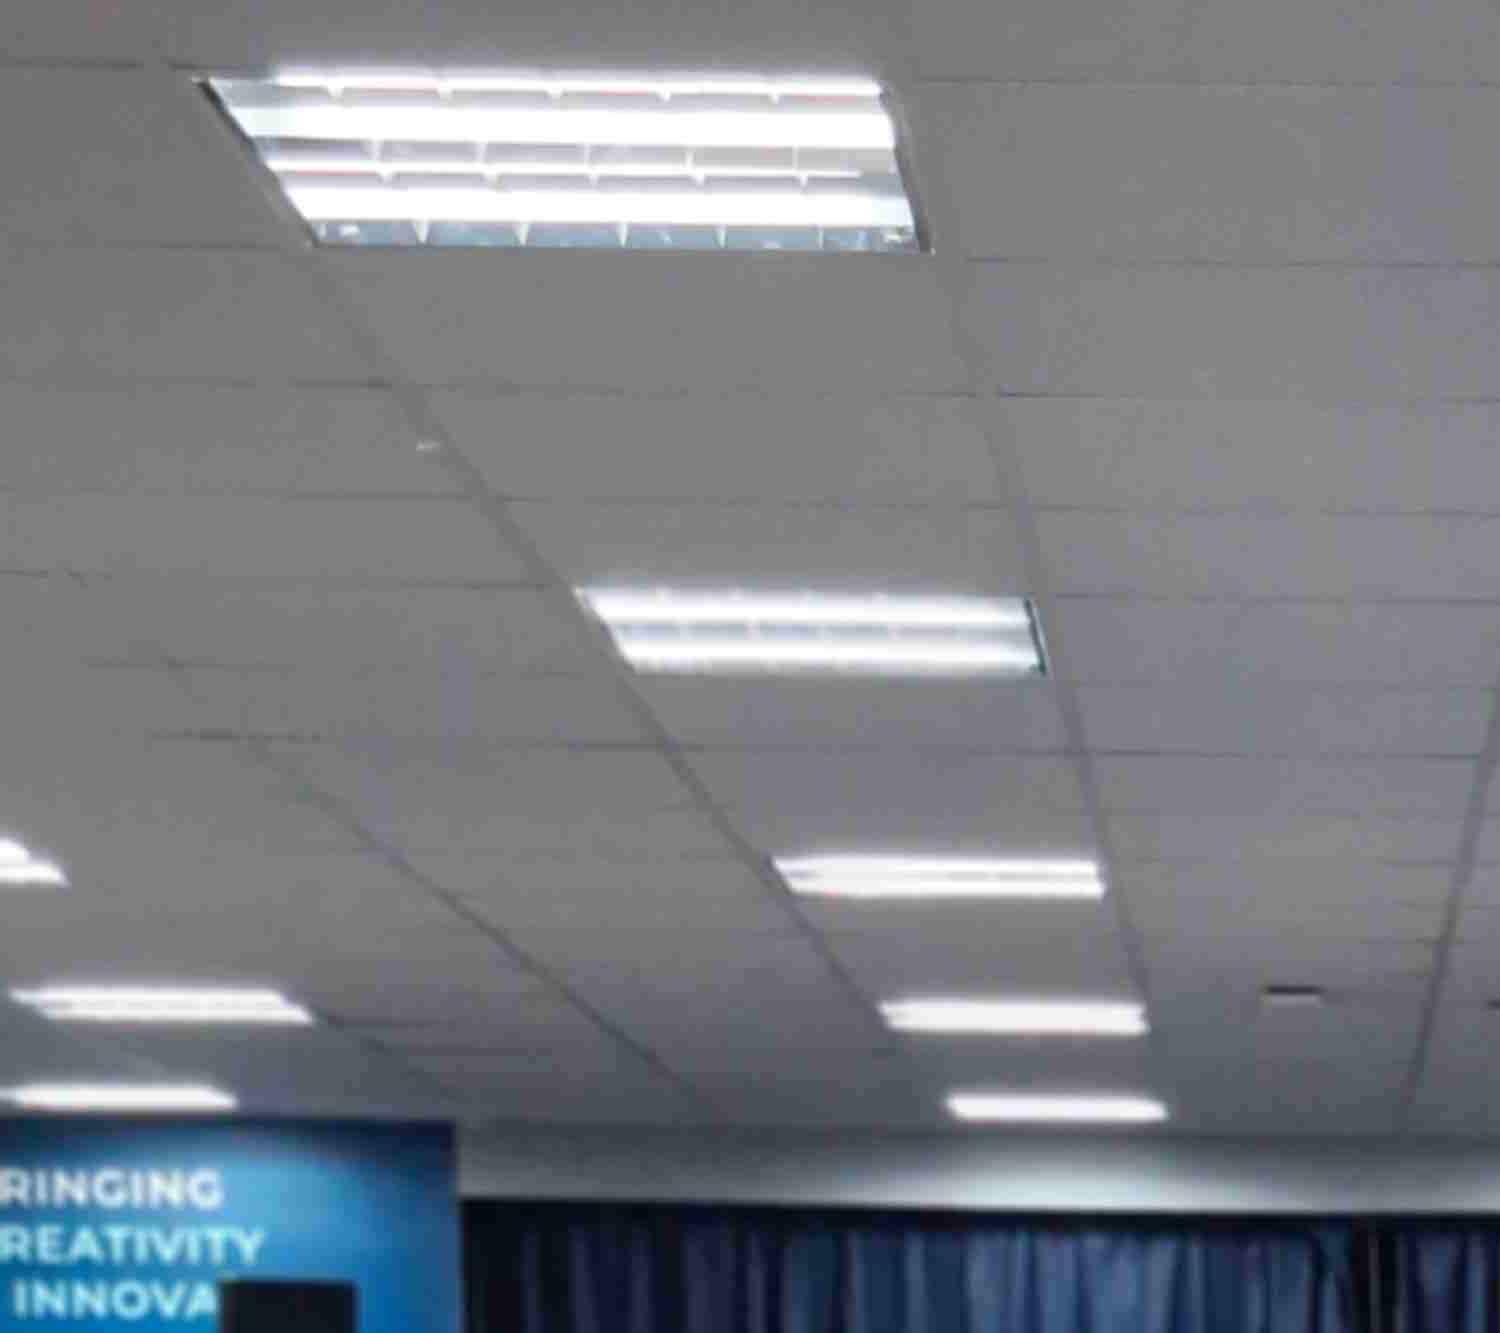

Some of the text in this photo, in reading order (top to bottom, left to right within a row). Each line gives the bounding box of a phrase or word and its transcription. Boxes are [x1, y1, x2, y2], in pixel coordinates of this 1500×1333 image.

[0, 1168, 223, 1208] RINGING
[0, 1225, 265, 1264] REATIVITY
[13, 1280, 218, 1319] INNOVA
